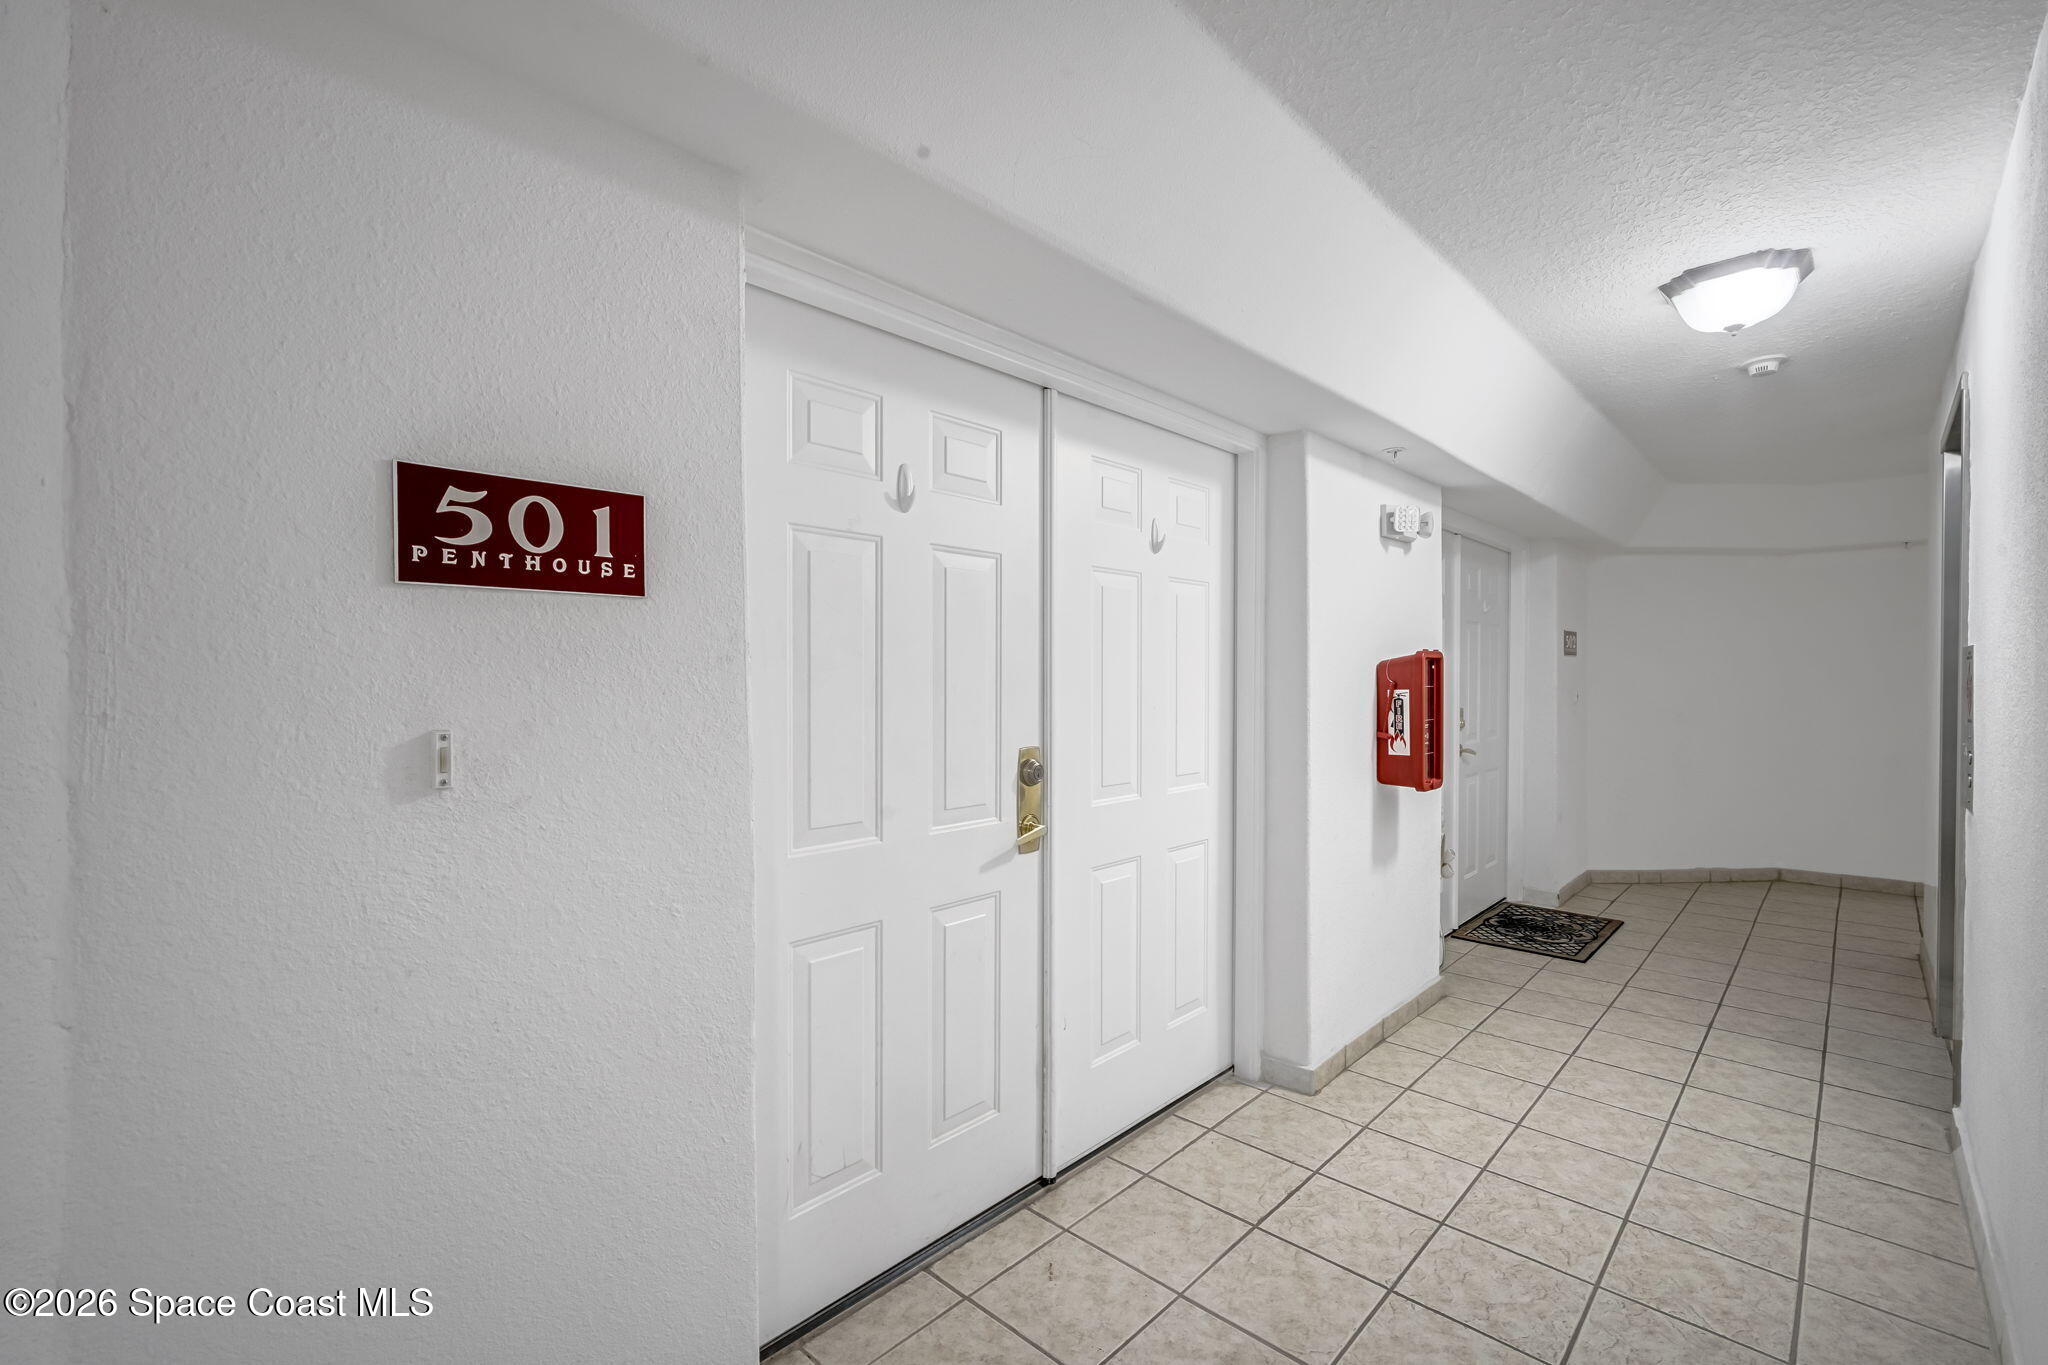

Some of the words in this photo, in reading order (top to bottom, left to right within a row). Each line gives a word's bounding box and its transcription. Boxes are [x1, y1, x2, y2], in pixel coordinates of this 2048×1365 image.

[434, 485, 613, 558] 501
[411, 545, 636, 578] PENTHOUSE
[1395, 700, 1403, 730] FIRE
